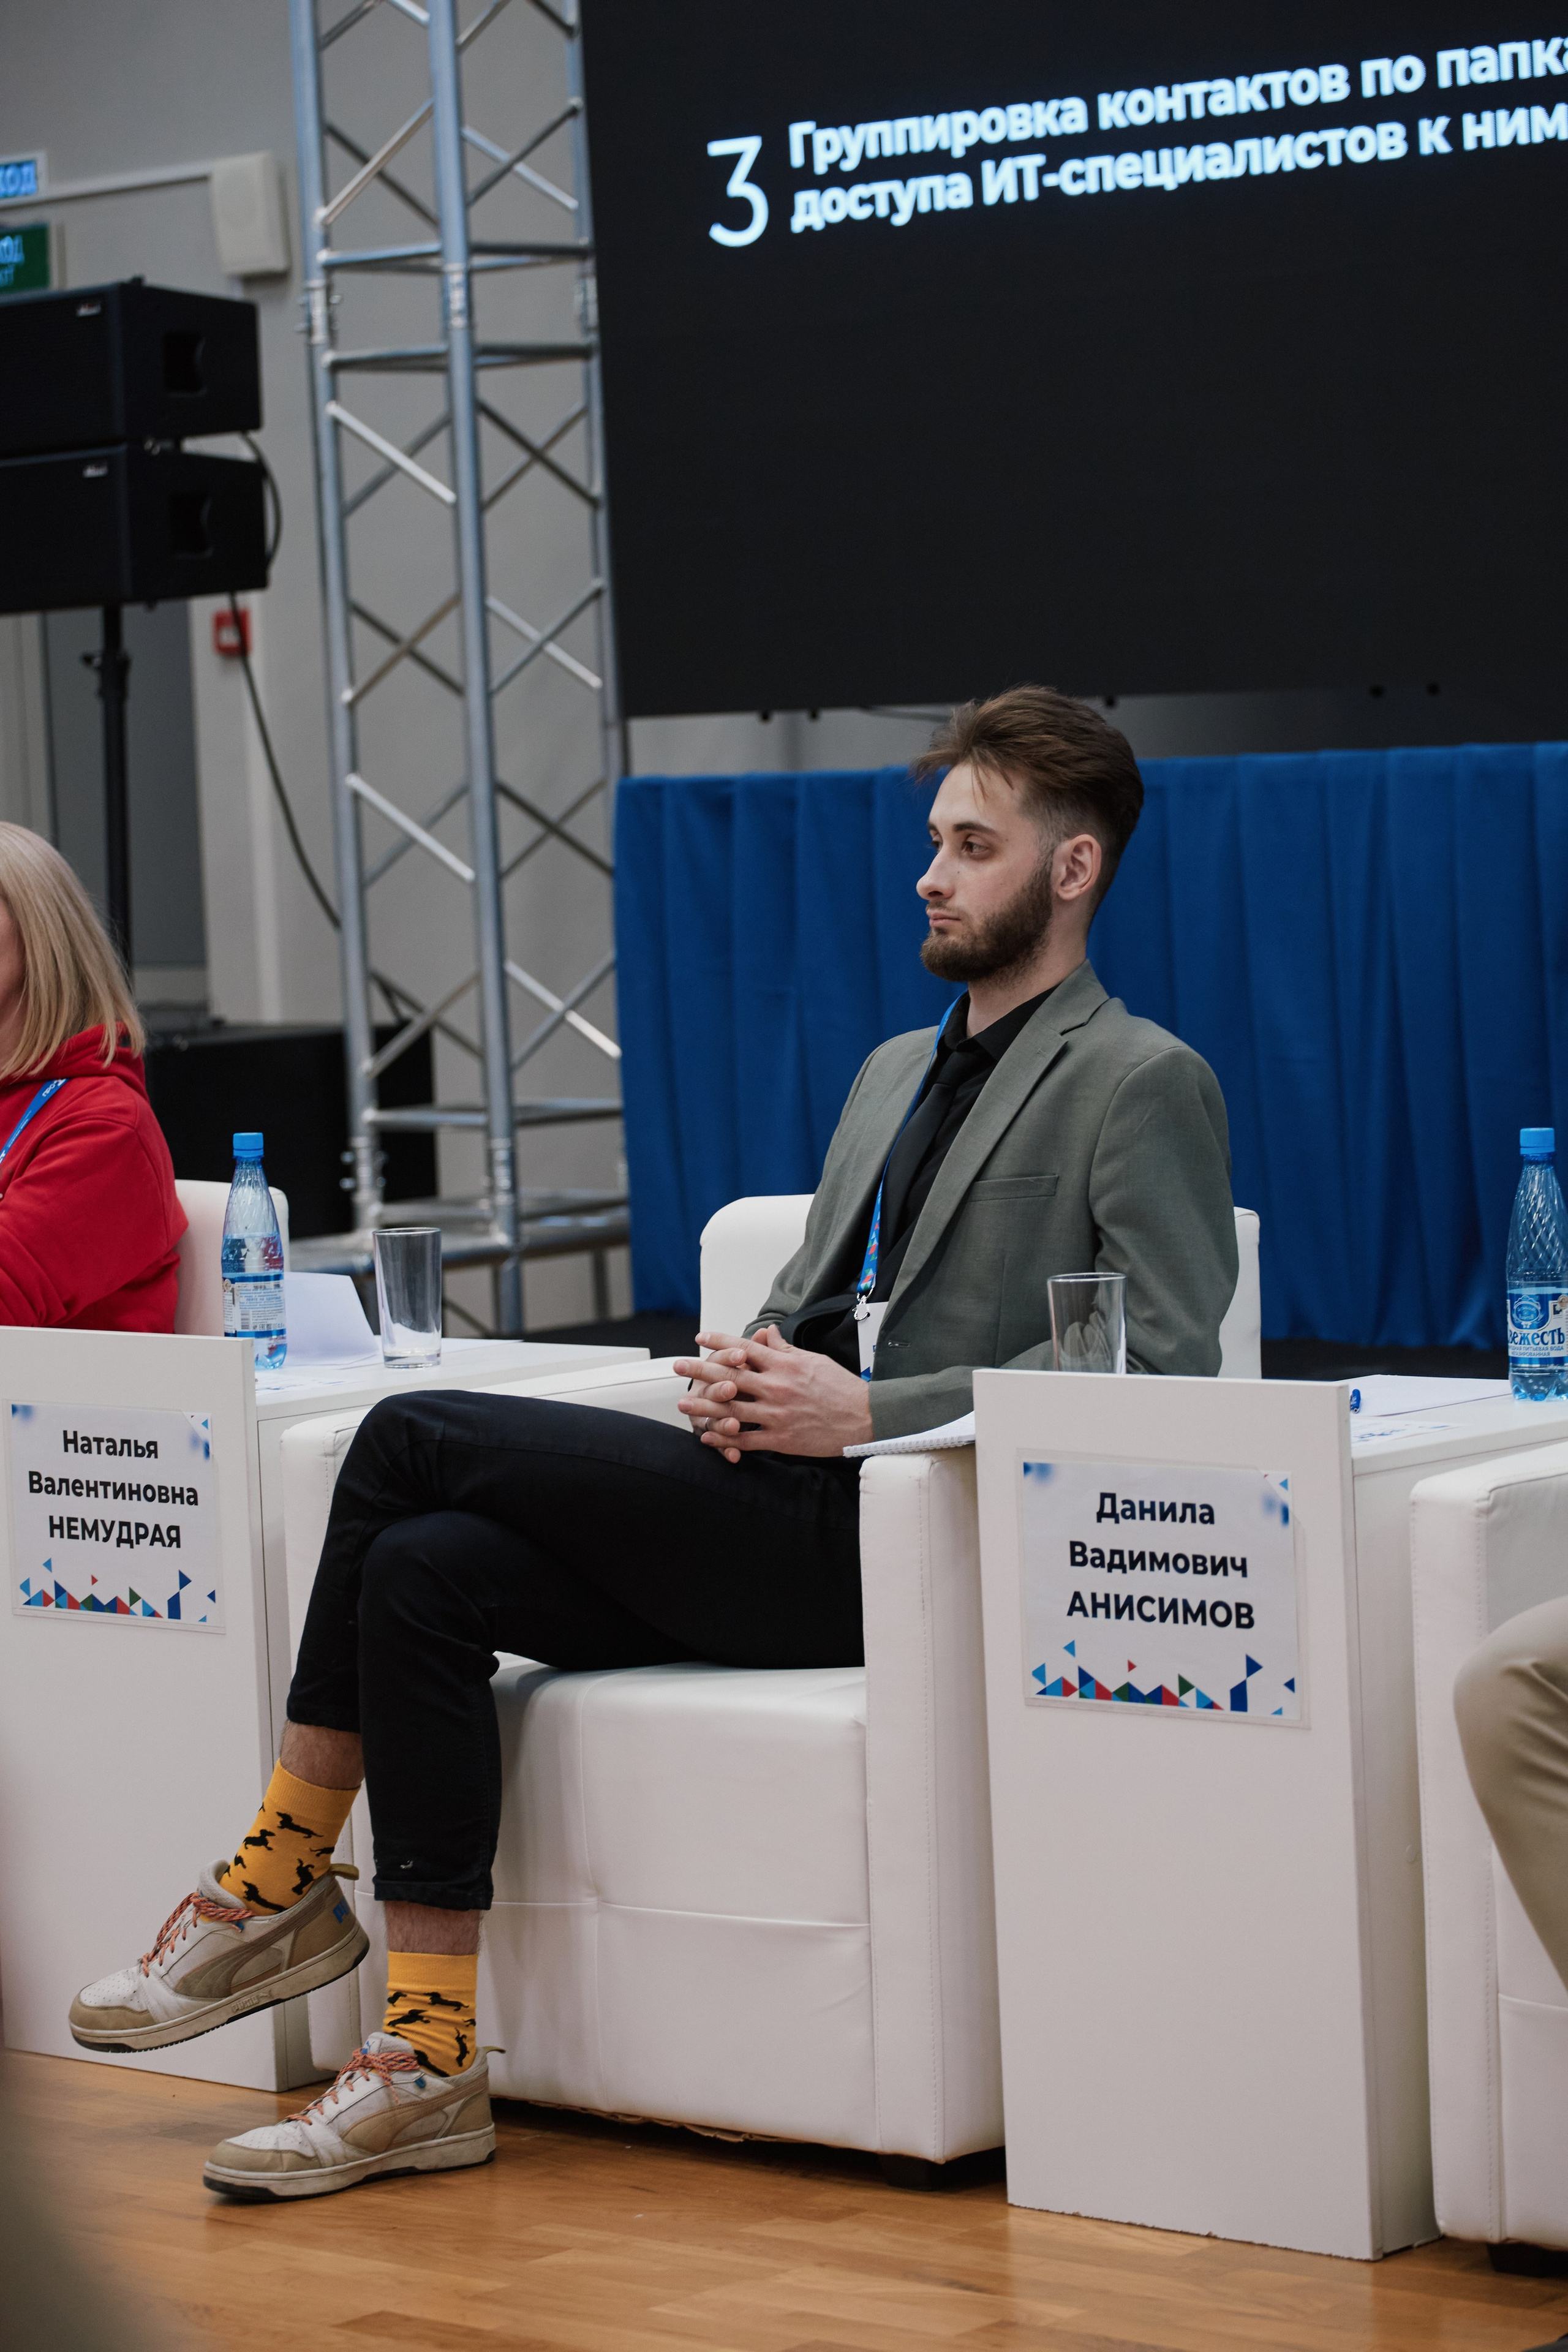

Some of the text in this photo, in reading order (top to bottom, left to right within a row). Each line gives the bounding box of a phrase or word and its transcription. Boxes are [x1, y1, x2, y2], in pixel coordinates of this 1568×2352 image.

[789, 37, 1568, 175] Группировка контактов по папк
[791, 103, 1568, 233] доступа ИТ-специалистов к ним
[707, 136, 768, 246] 3
[1509, 1327, 1565, 1346] вежесть
[63, 1430, 158, 1459] Наталья
[29, 1471, 198, 1506] Валентиновна
[1096, 1493, 1215, 1525] Данила
[49, 1515, 181, 1549] НЕМУДРАЯ
[1070, 1541, 1247, 1578] Вадимович
[1067, 1591, 1254, 1629] АНИСИМОВ
